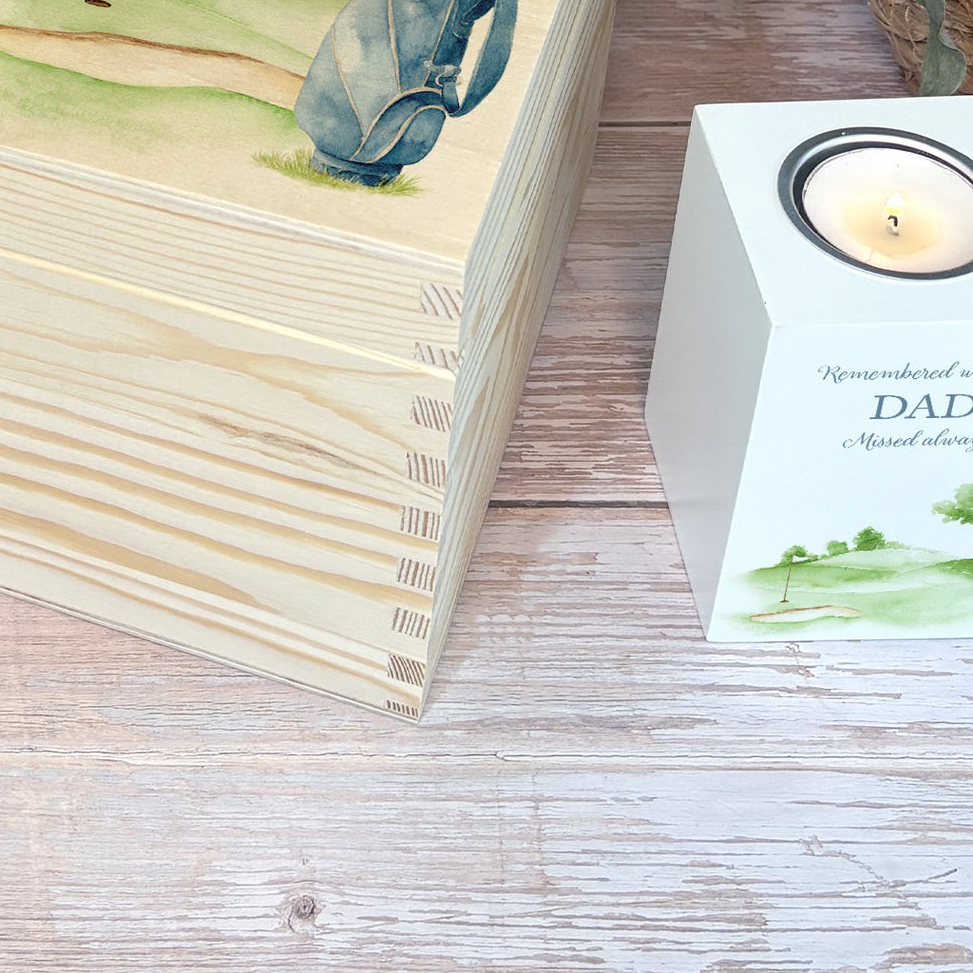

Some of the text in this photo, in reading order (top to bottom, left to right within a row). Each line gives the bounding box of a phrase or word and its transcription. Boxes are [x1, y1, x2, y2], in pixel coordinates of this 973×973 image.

[817, 361, 960, 384] Remembered
[869, 393, 973, 420] DAD
[842, 429, 924, 451] Missed
